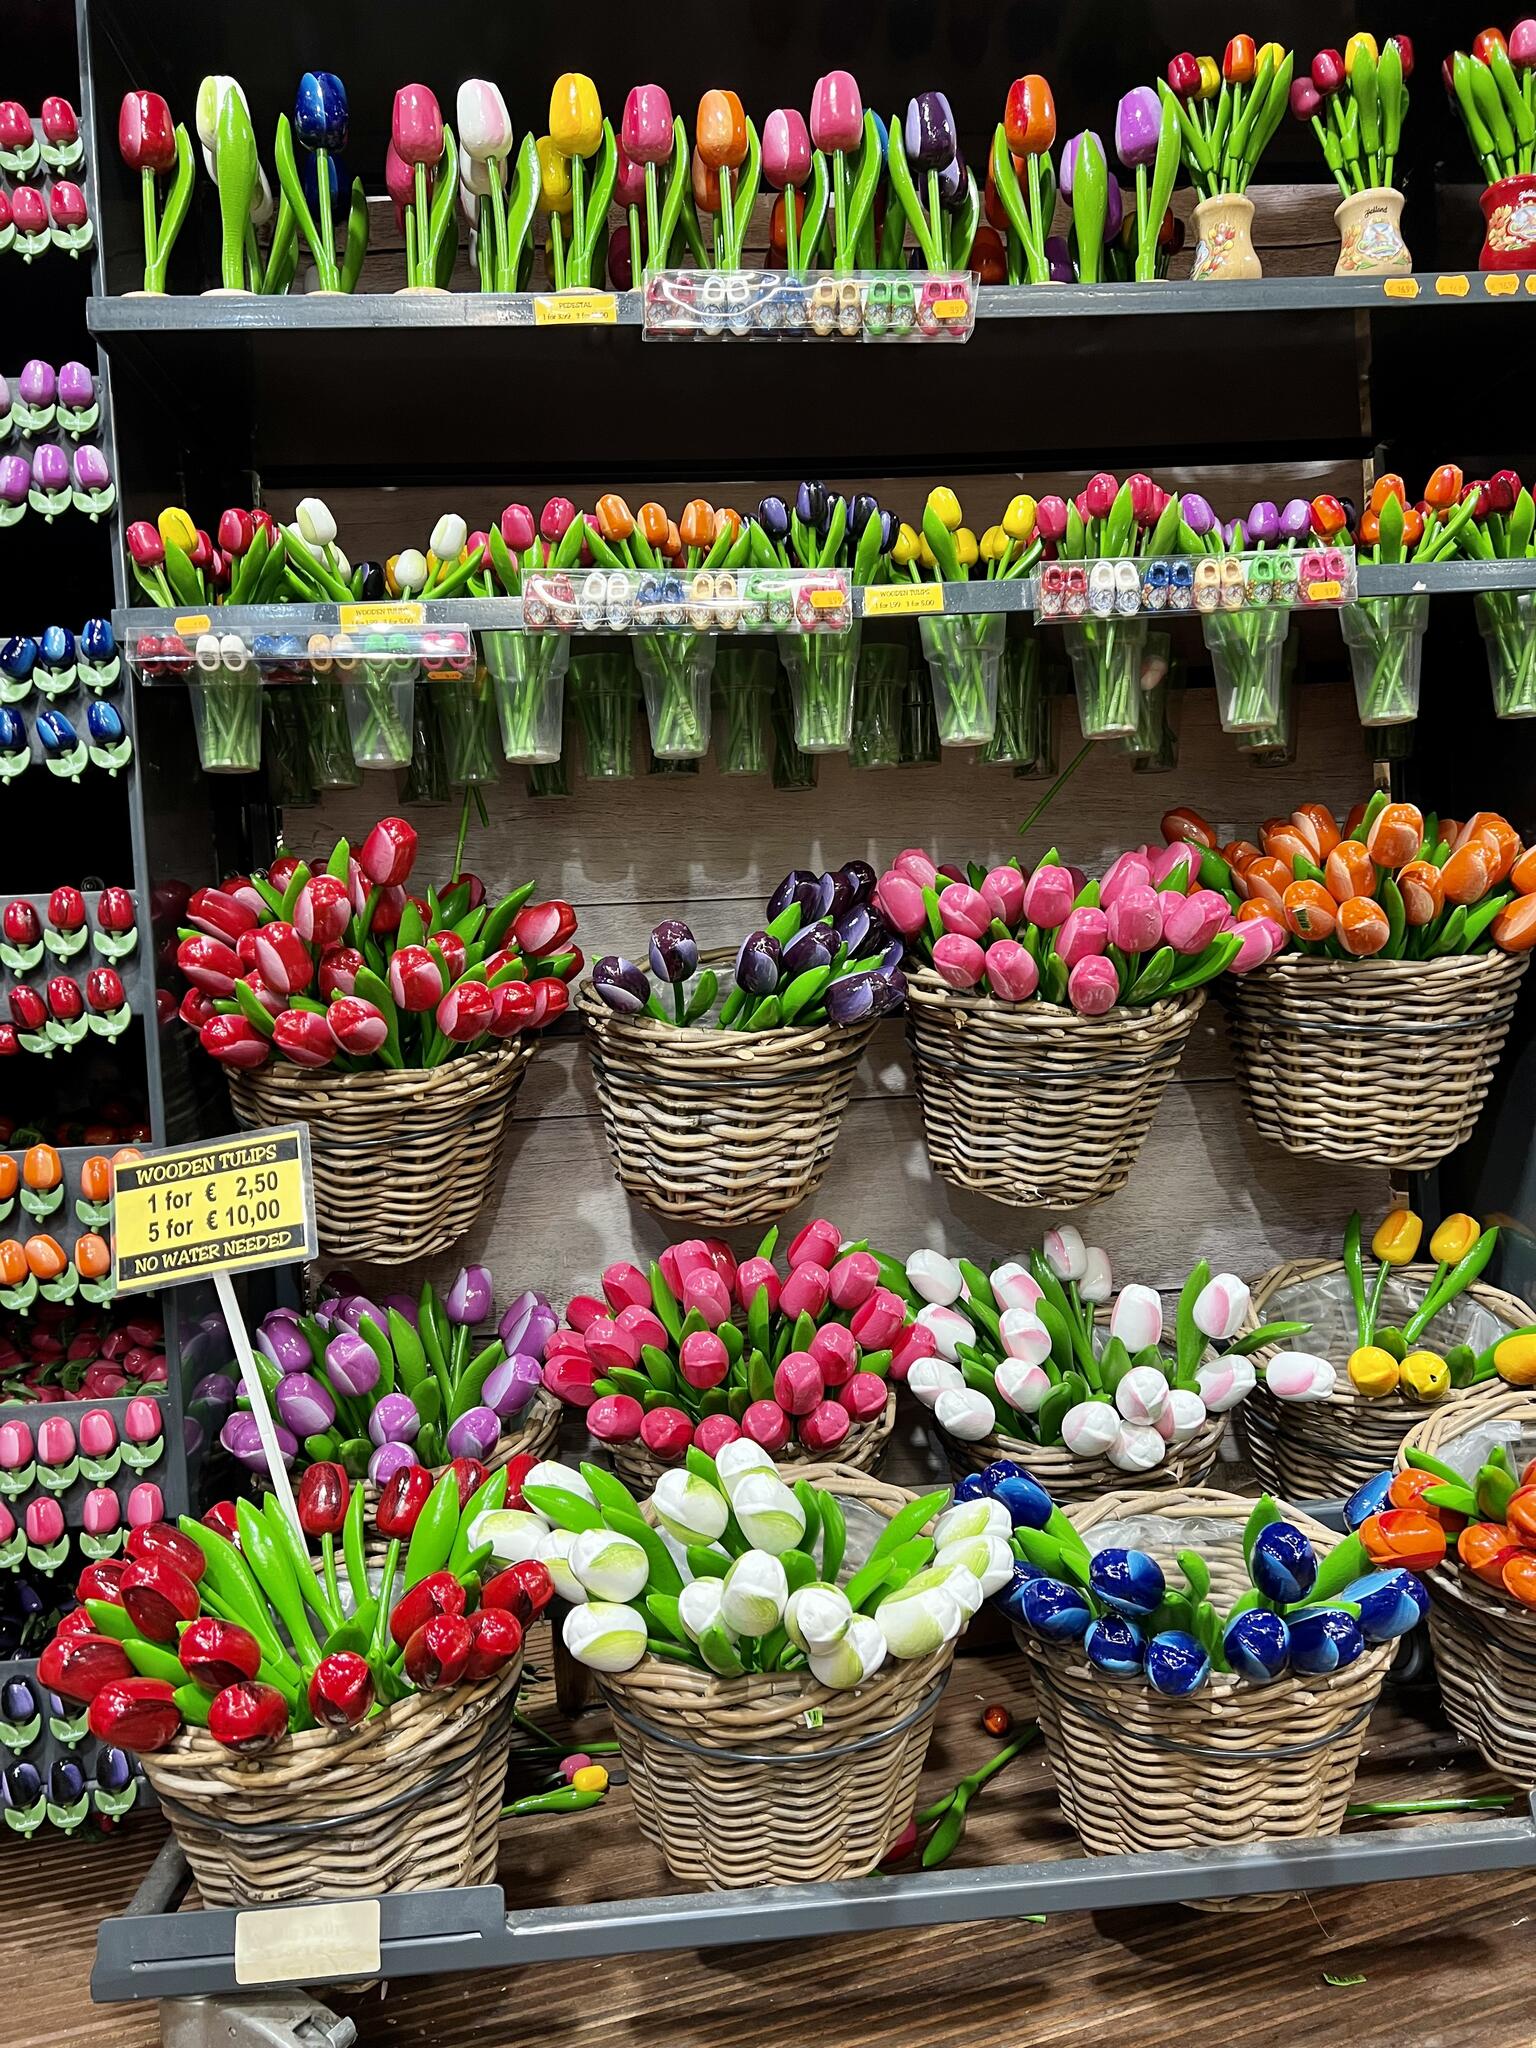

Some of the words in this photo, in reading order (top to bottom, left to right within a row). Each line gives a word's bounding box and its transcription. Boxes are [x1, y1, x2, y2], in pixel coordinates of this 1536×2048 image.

[558, 301, 592, 309] PEDESTAL
[879, 601, 888, 609] for
[880, 589, 909, 597] WOODEN
[910, 588, 931, 596] TULIPS
[355, 608, 386, 616] WOODEN
[136, 1155, 216, 1186] WOODEN
[219, 1144, 278, 1169] TULIPS
[147, 1194, 157, 1214] 1
[165, 1190, 193, 1211] for
[205, 1182, 217, 1202] €
[235, 1170, 279, 1199] 2,50
[148, 1222, 160, 1243] 5
[166, 1218, 194, 1239] for
[206, 1210, 219, 1231] €
[225, 1199, 281, 1228] 10,00
[134, 1257, 159, 1275] NO
[161, 1244, 220, 1269] WATER
[223, 1231, 292, 1257] NEEDED
